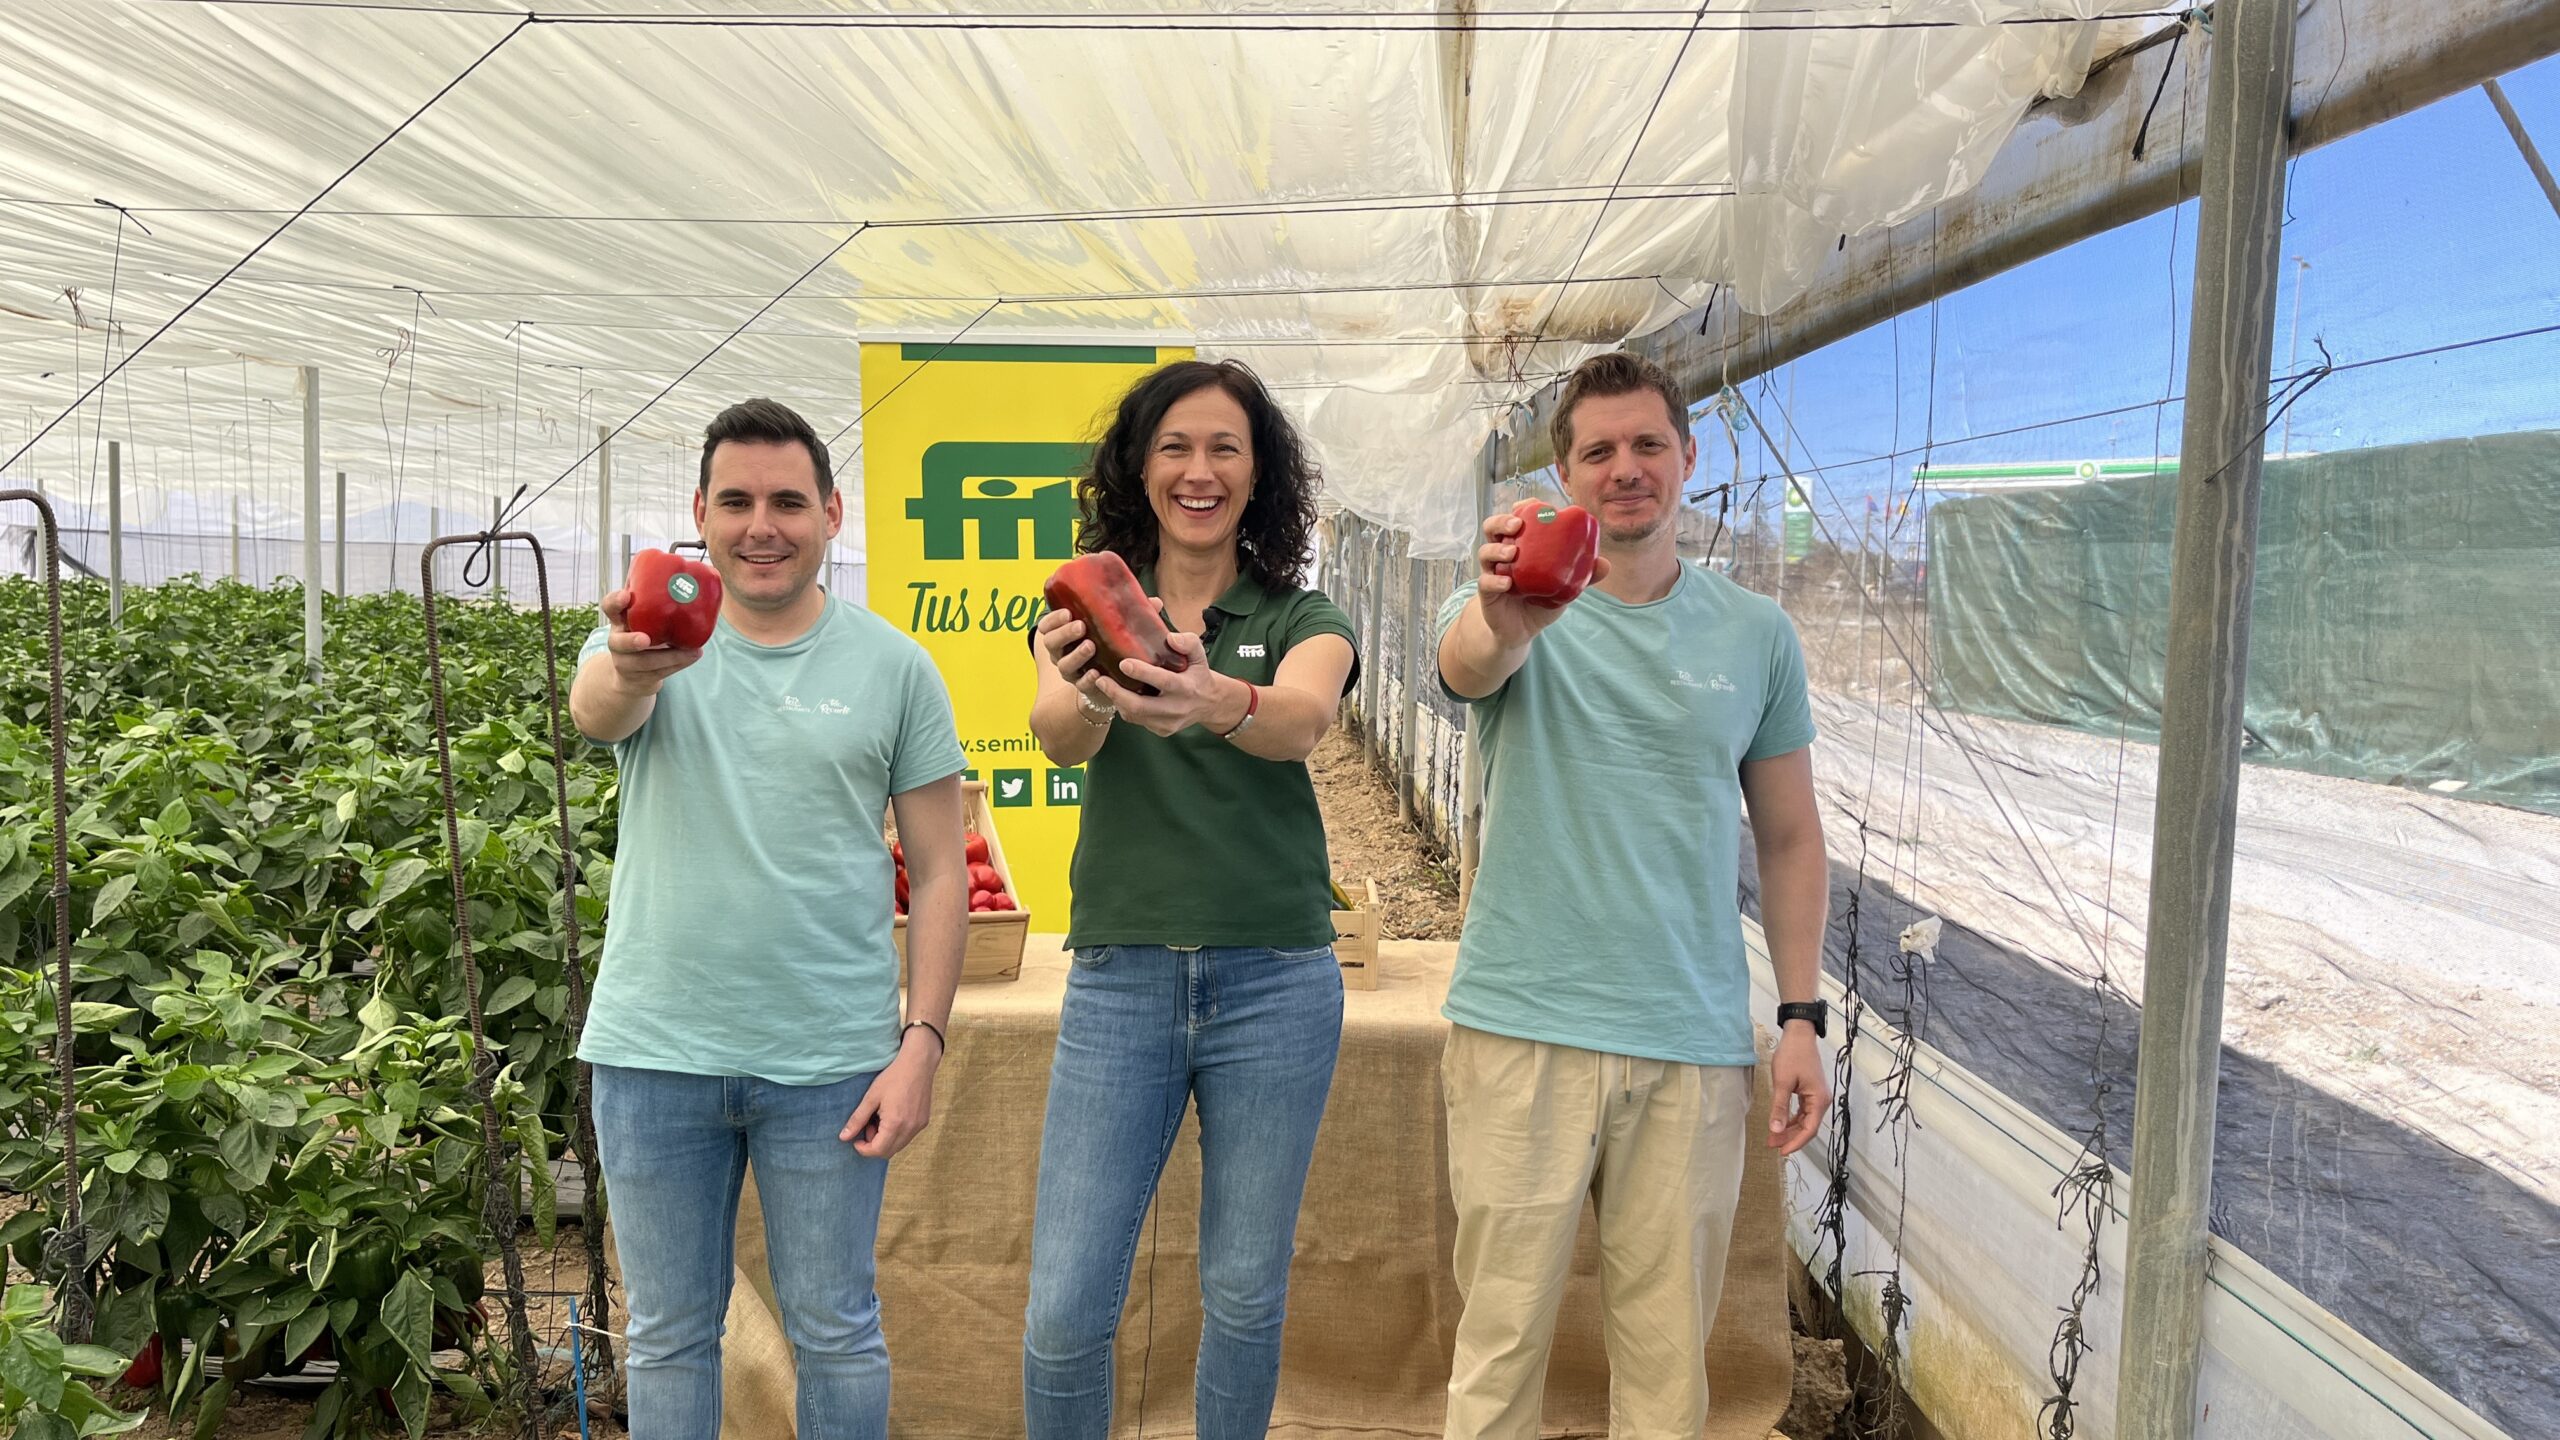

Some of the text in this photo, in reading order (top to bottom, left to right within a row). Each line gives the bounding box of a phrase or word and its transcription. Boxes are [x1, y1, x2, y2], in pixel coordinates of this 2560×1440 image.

[905, 442, 1104, 560] fit
[907, 582, 970, 632] Tus
[1053, 775, 1078, 800] in
